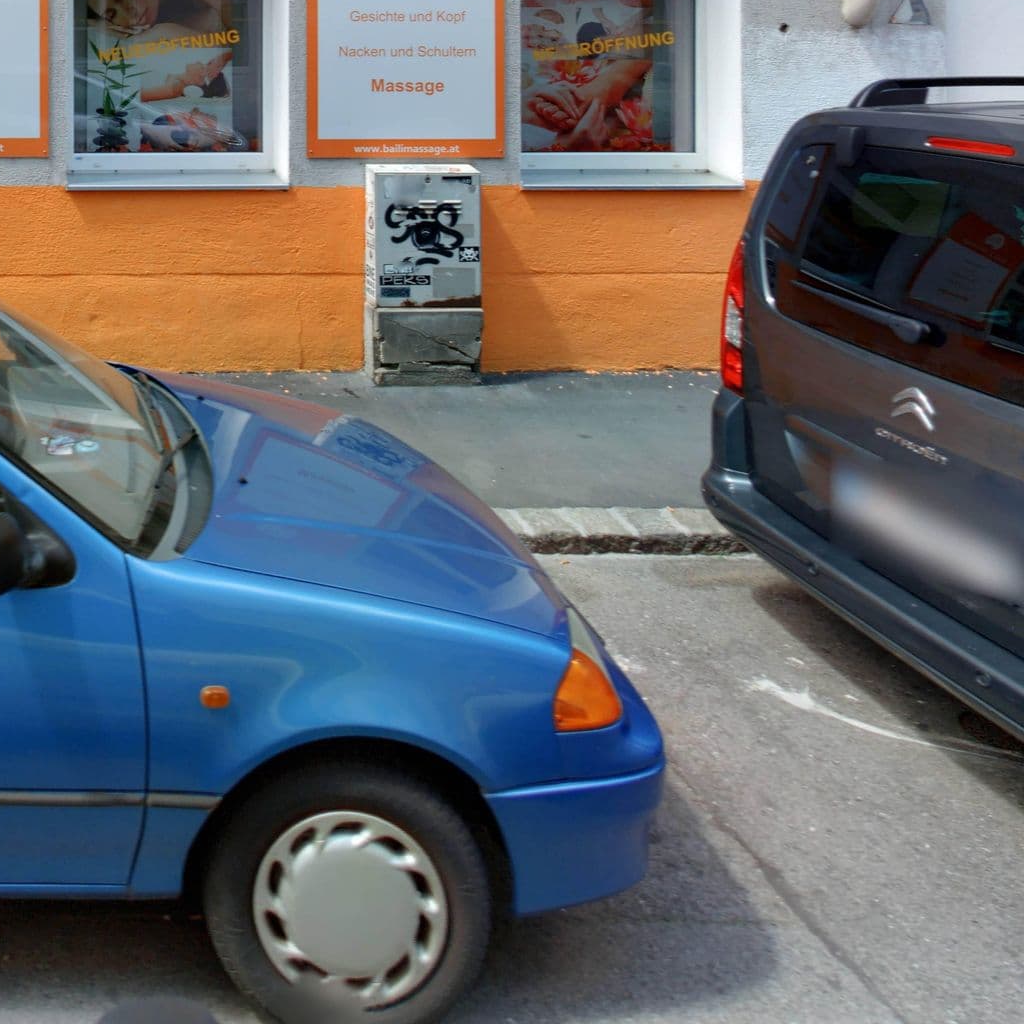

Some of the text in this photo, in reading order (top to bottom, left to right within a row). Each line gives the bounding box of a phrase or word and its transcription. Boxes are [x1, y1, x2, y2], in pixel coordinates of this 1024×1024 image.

[350, 10, 467, 24] Gesichte und Kopf
[338, 45, 477, 58] Nacken und Schultern
[370, 78, 446, 97] Massage
[354, 144, 461, 156] www.bailimassage.at
[382, 275, 429, 285] PEKS
